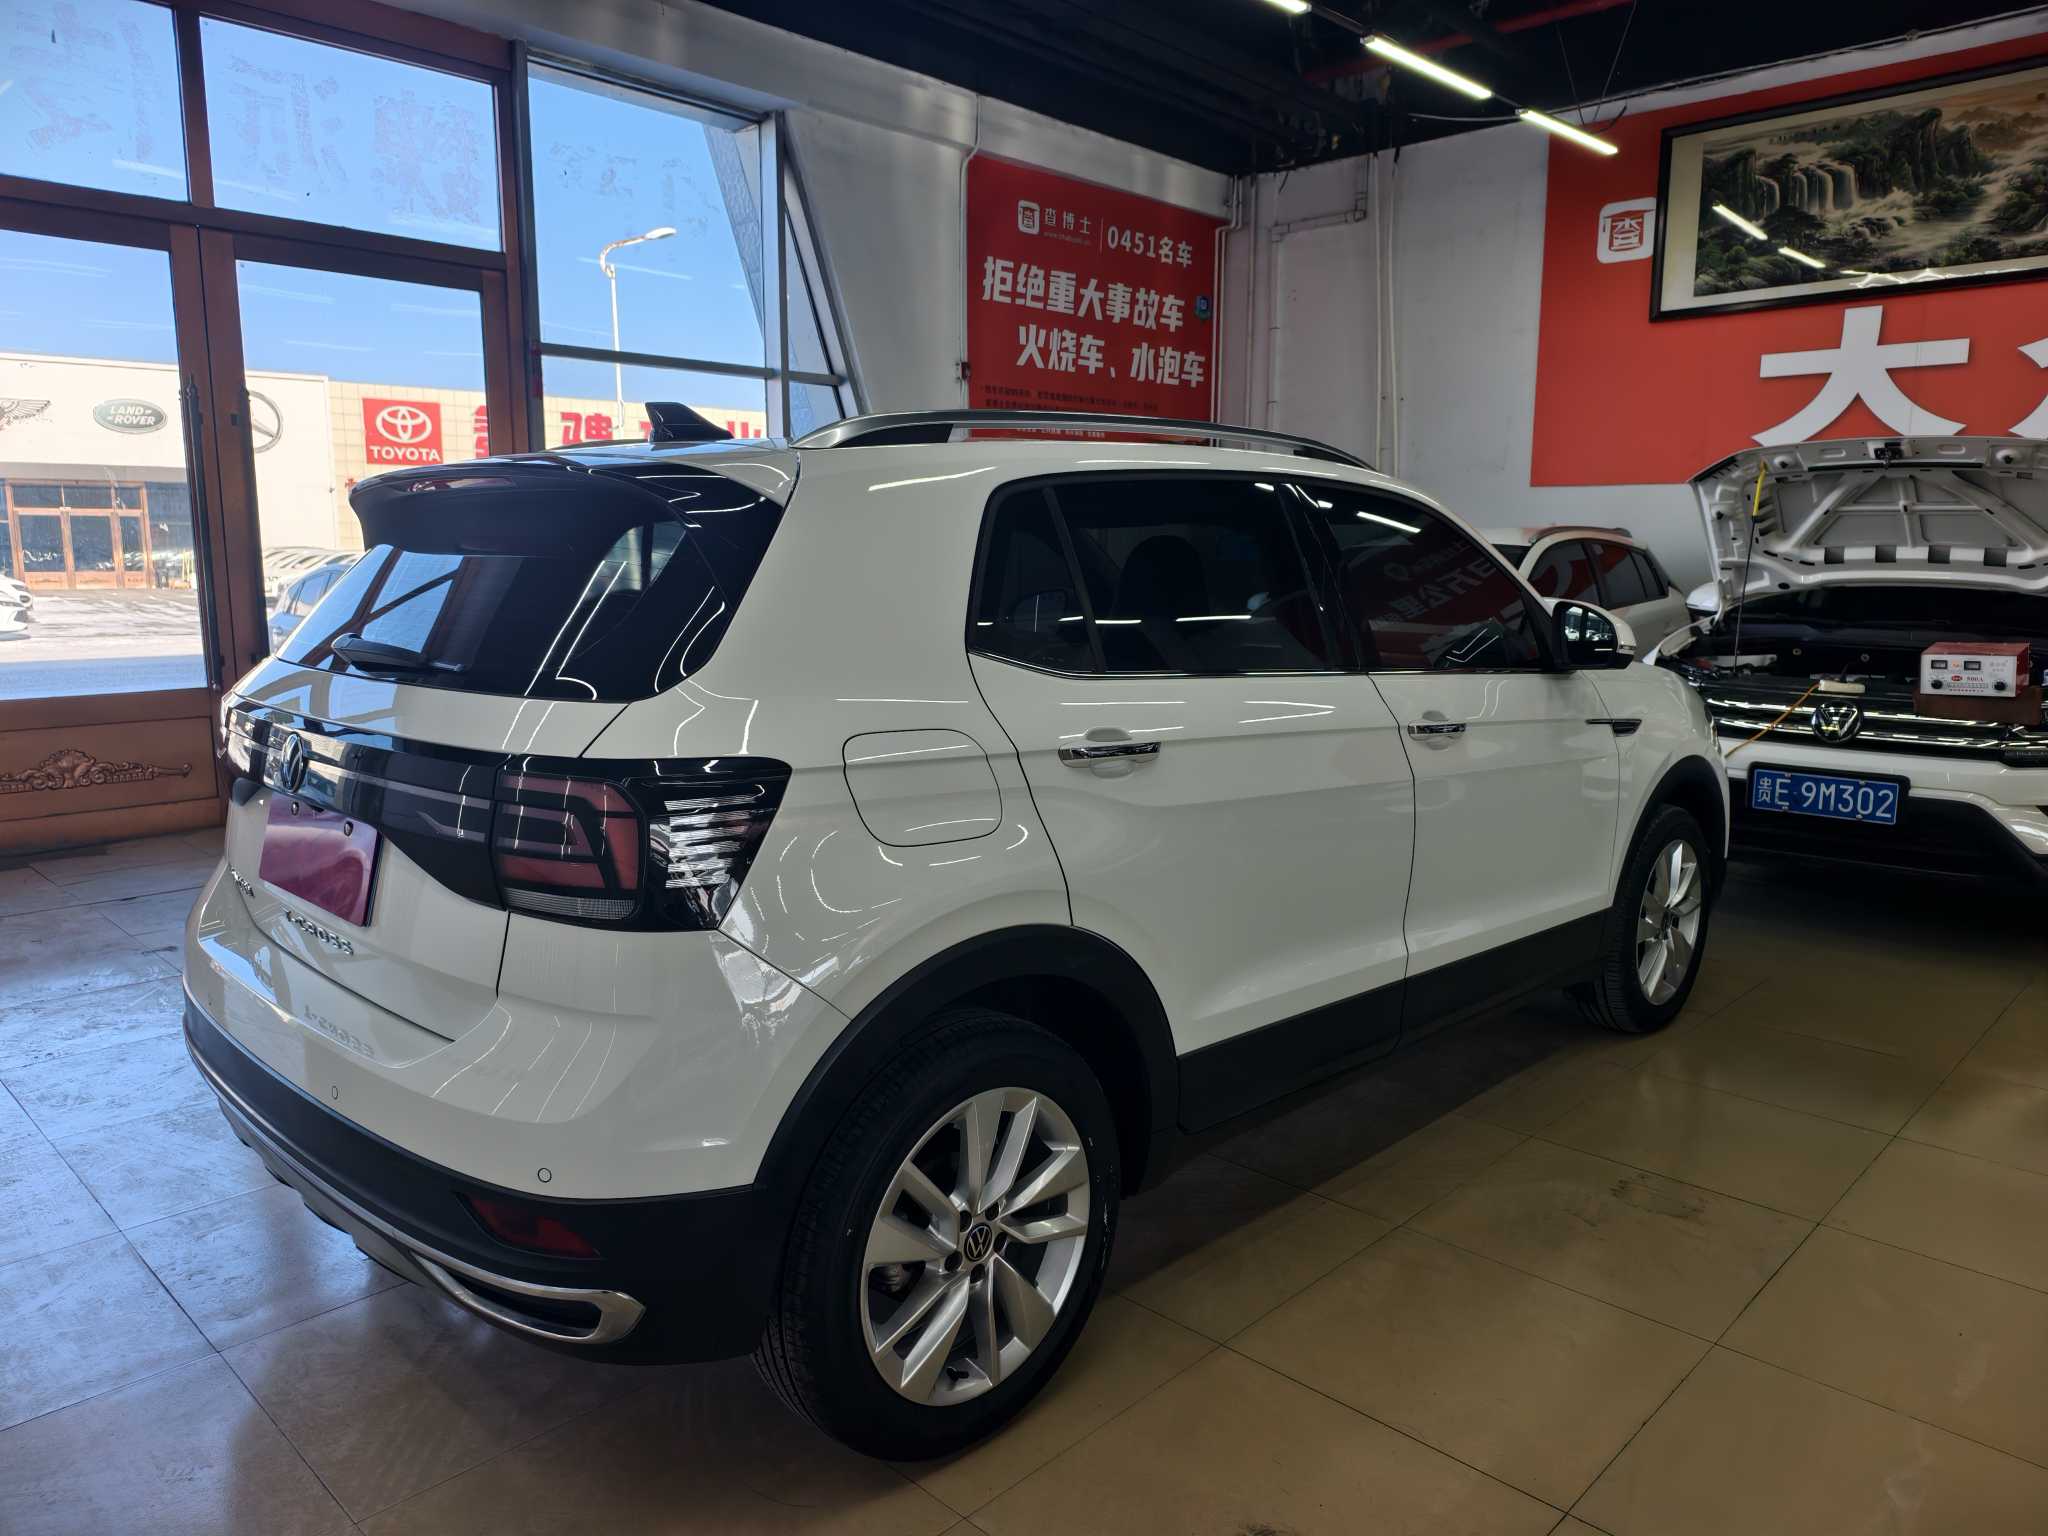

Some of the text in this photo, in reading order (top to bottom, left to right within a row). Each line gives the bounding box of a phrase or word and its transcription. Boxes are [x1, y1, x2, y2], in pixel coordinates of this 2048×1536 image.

[1107, 225, 1193, 268] 0451名车
[982, 256, 1186, 333] 拒绝重大事故车
[1016, 324, 1206, 388] 火烧车、水泡车
[1751, 304, 2048, 443] 大
[111, 405, 144, 416] LAND
[114, 414, 155, 425] ROVER
[369, 445, 441, 462] TOYOTA
